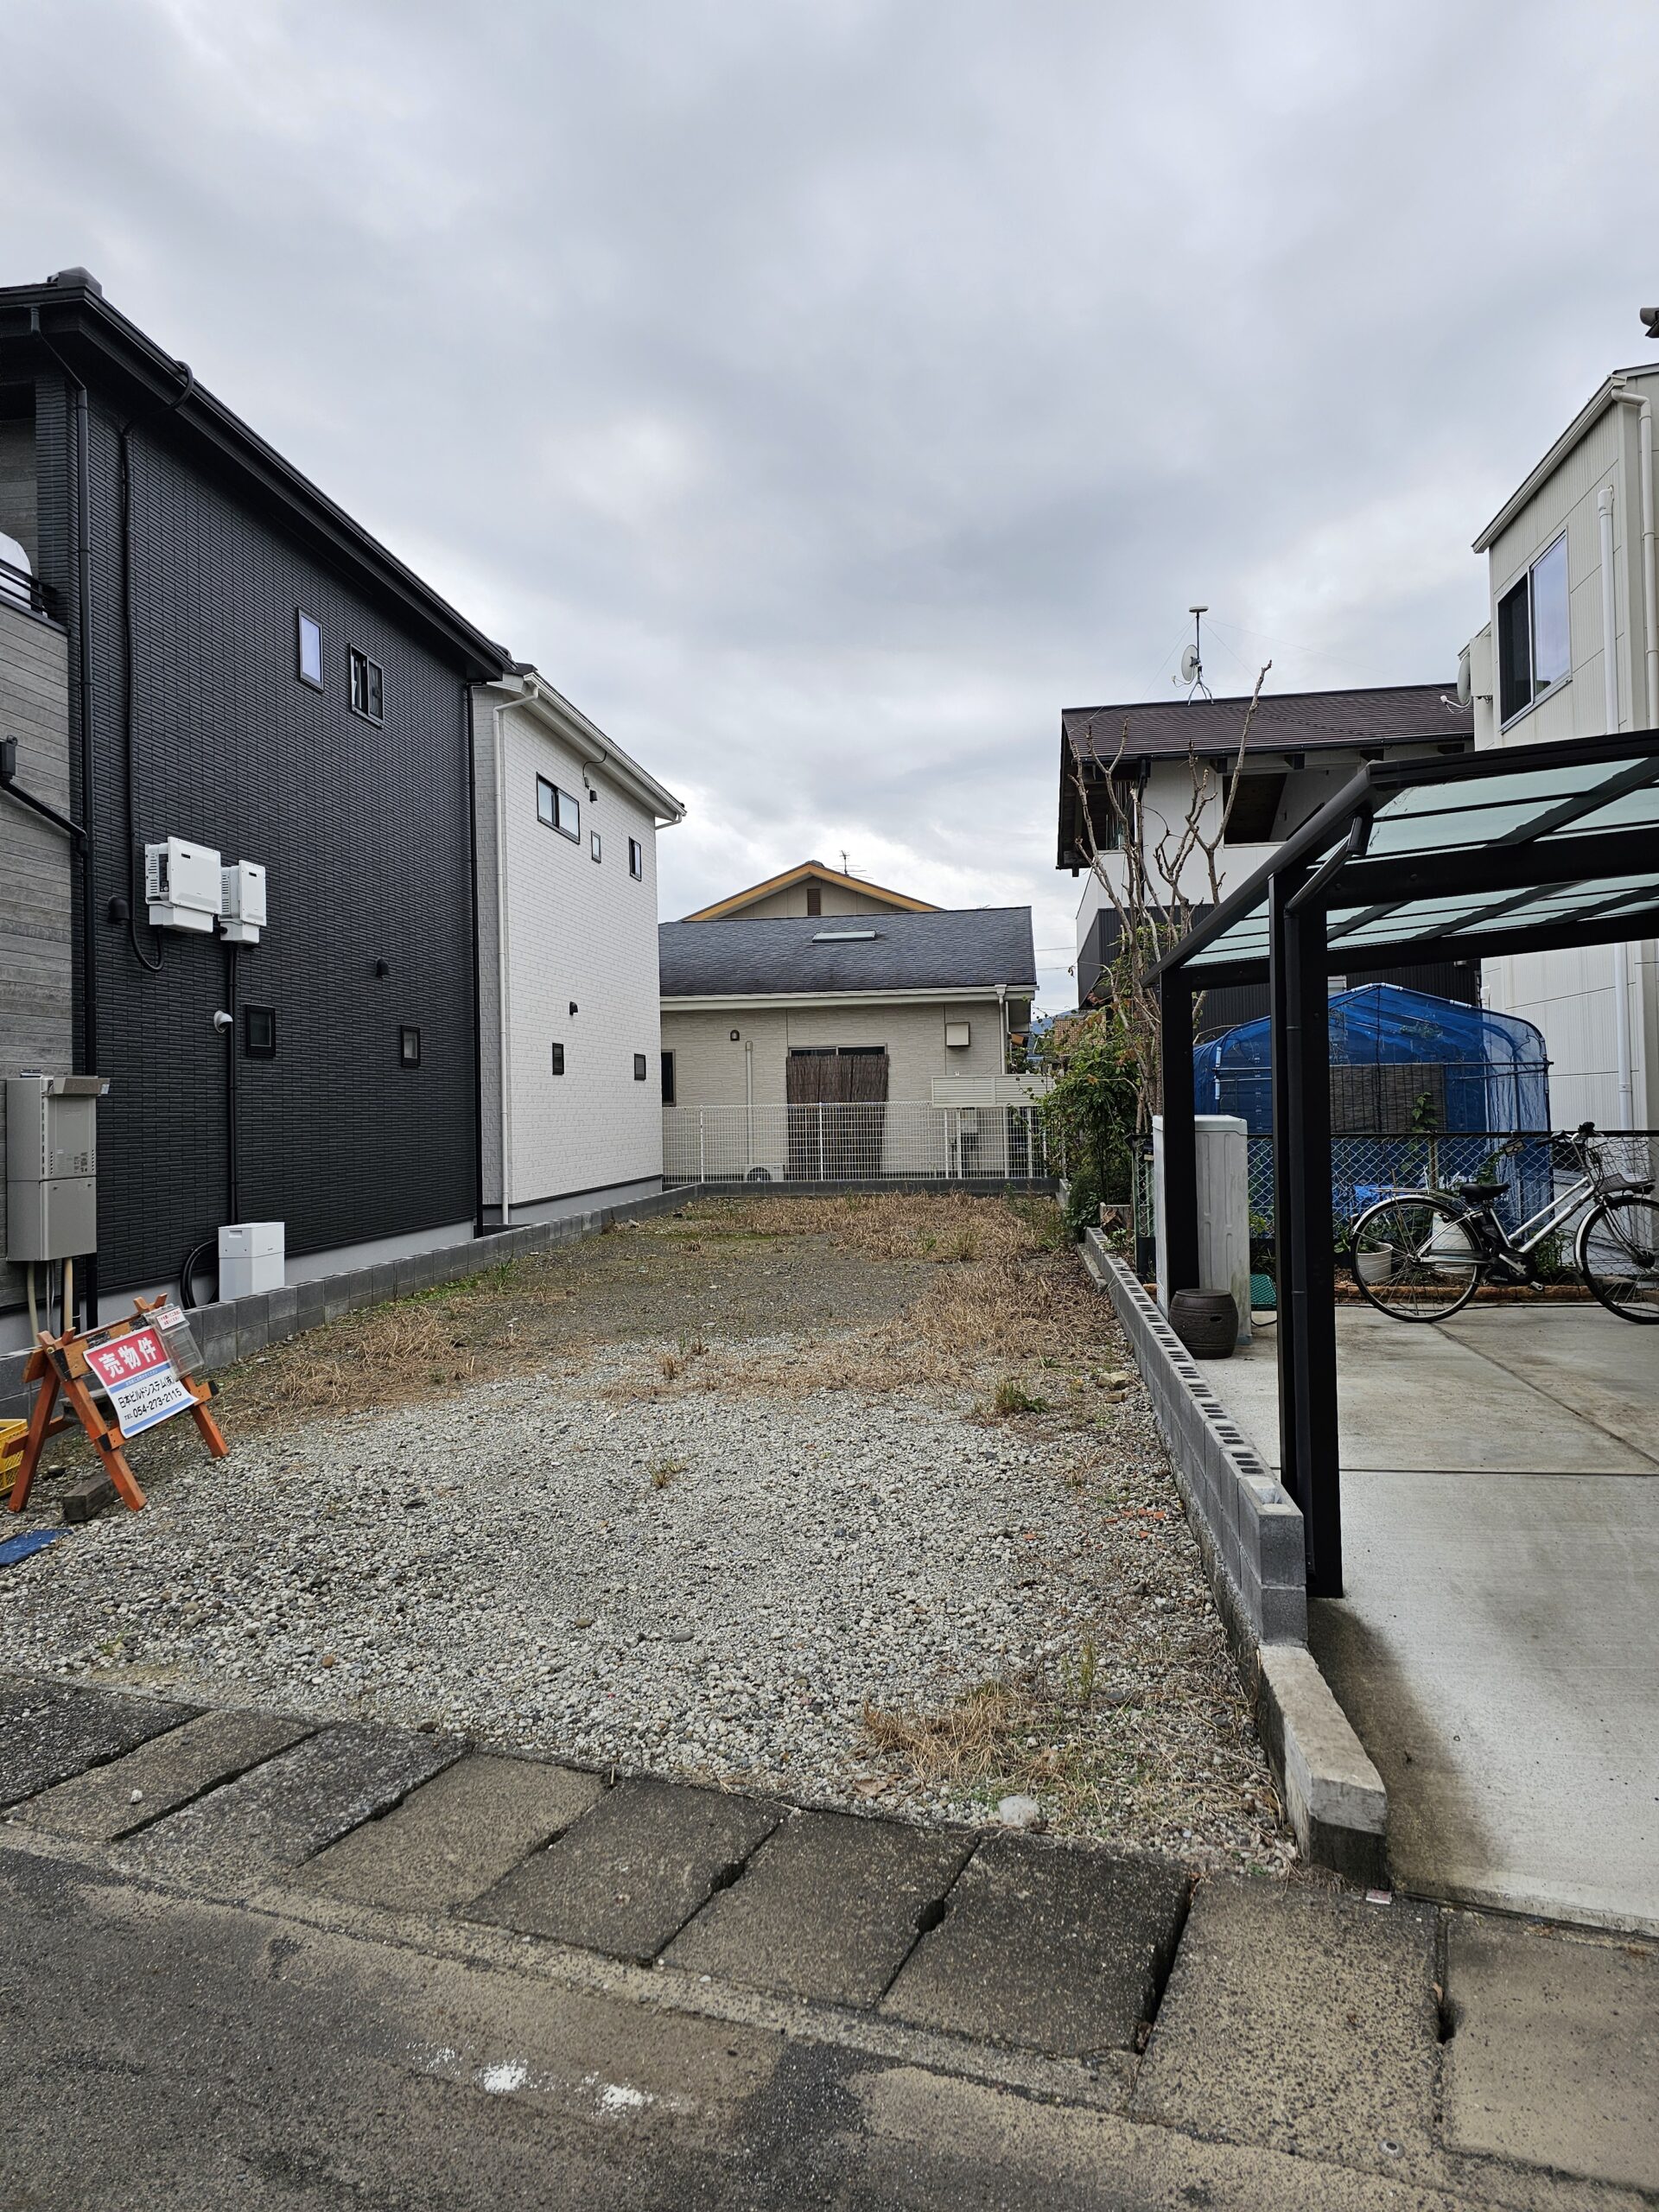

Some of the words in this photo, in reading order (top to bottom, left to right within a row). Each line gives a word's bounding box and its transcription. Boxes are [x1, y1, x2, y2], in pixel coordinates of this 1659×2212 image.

[98, 1337, 157, 1378] 売物件
[132, 1388, 182, 1418] 054-273-2115
